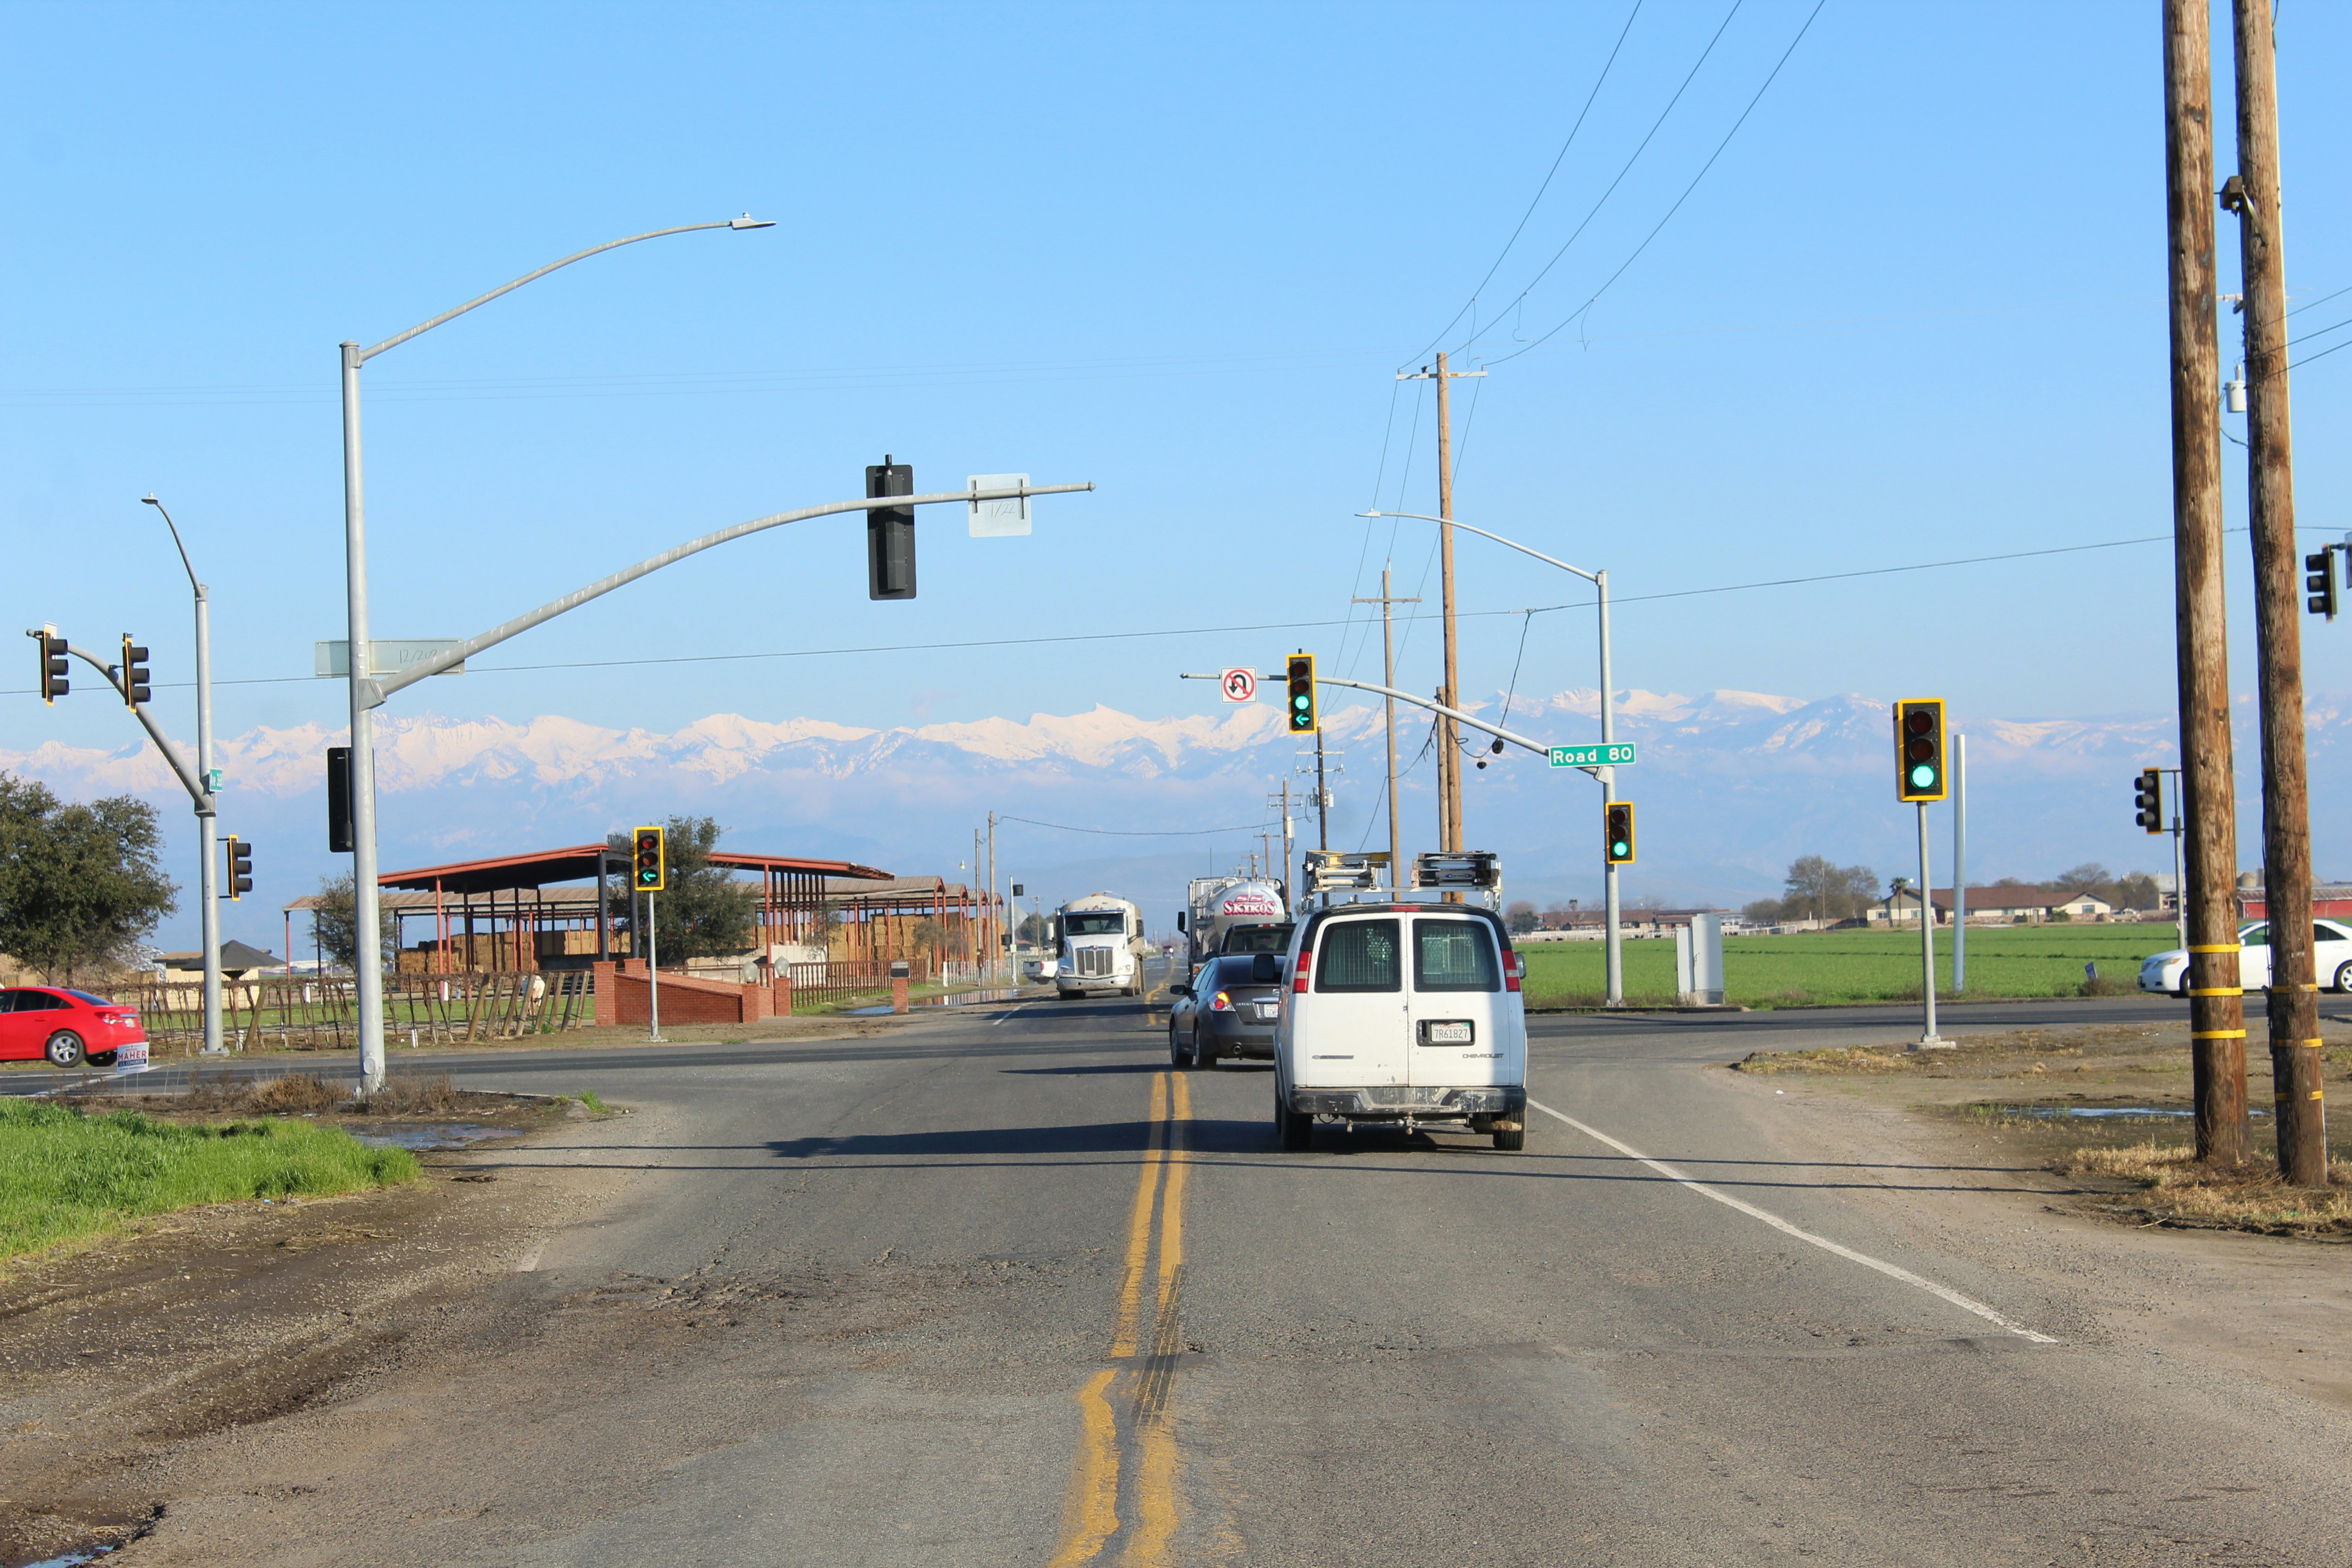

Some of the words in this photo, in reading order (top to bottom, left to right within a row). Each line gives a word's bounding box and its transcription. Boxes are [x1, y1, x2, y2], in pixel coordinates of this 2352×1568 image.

[991, 501, 1015, 518] 1/22
[1553, 749, 1597, 764] Road
[1608, 747, 1632, 761] 80
[1224, 900, 1276, 916] SKIKOS
[1434, 1029, 1468, 1039] 7R61827
[118, 1050, 147, 1061] MAHER
